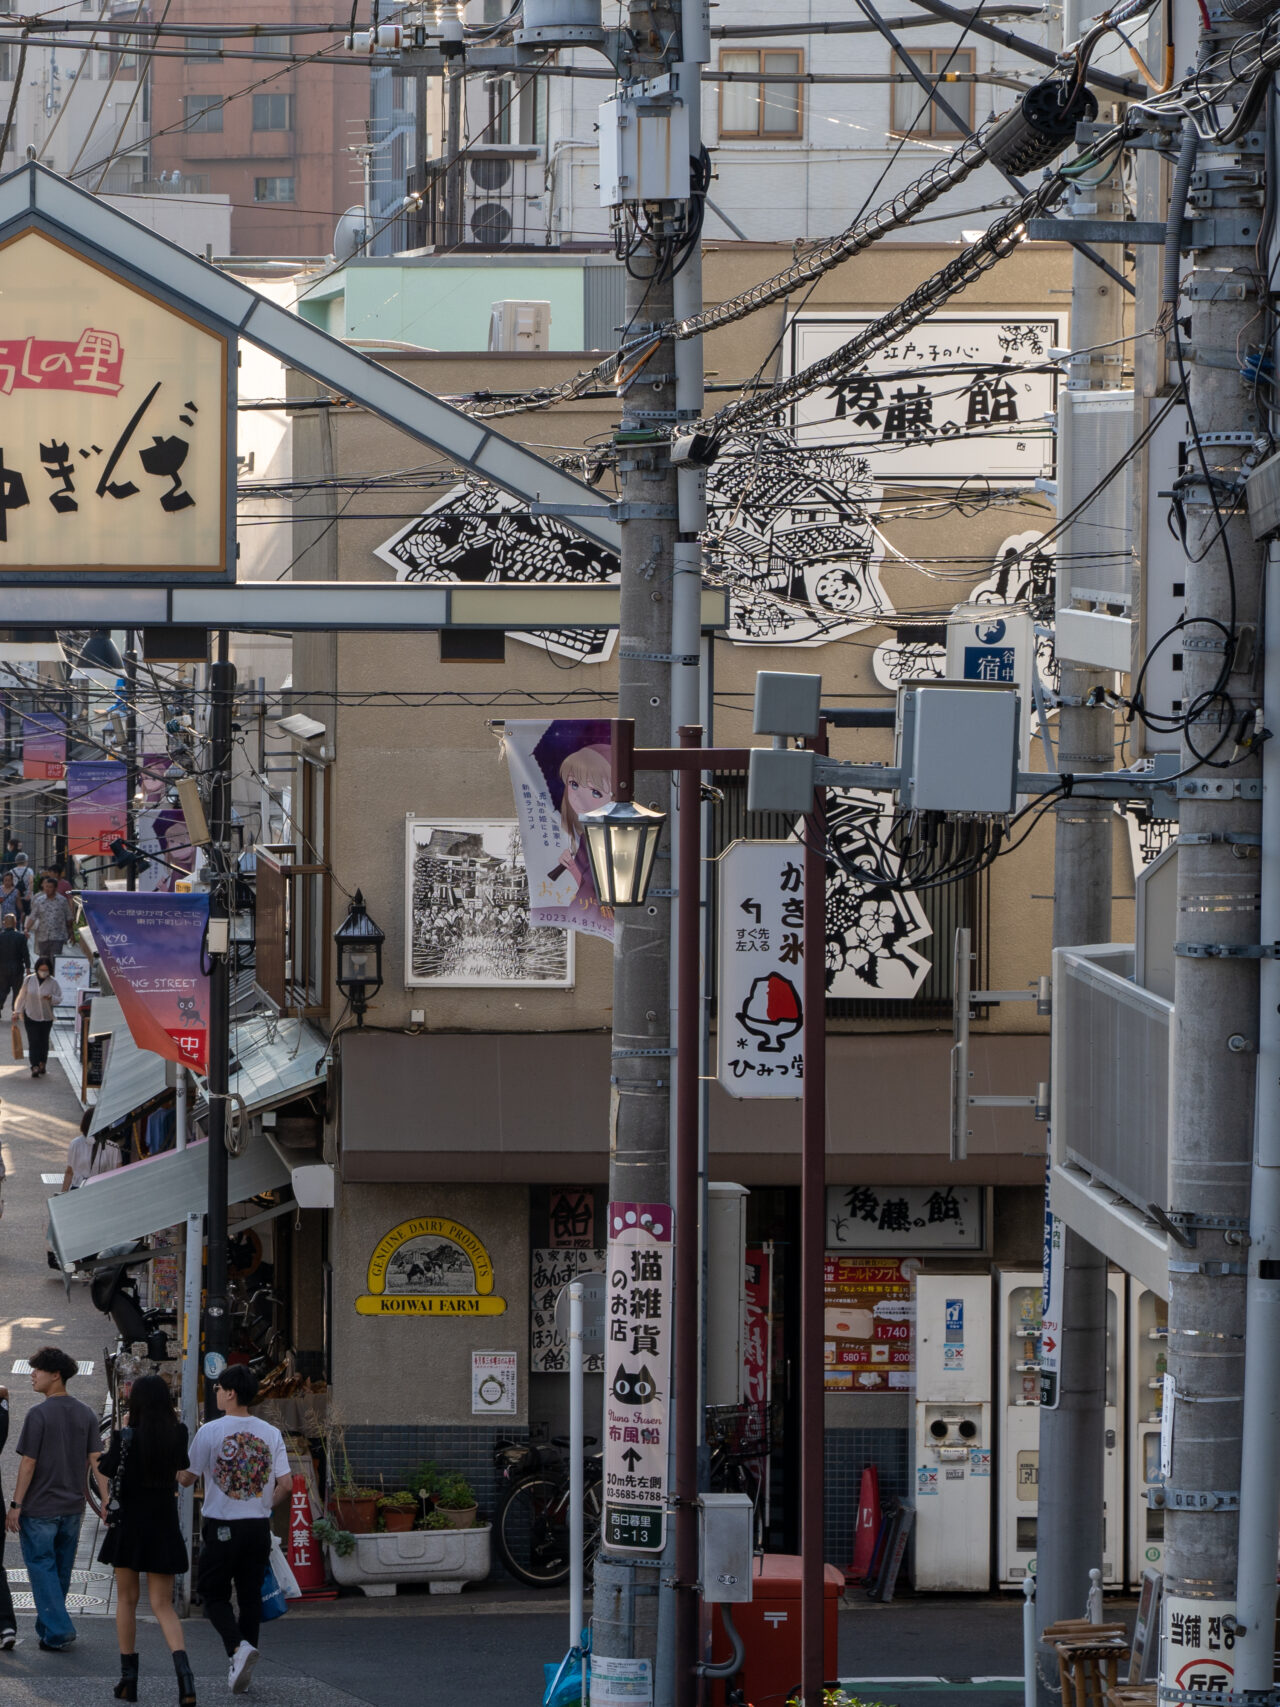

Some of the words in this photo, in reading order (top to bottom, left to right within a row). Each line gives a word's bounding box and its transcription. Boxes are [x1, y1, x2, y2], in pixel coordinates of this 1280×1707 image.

[883, 342, 980, 361] 江戸っ子の心
[825, 356, 1018, 447] 後藤の飴
[977, 655, 1000, 680] 宿
[1002, 650, 1015, 680] 谷中
[736, 928, 770, 940] すぐ先
[736, 940, 770, 952] 左入る
[155, 978, 197, 988] STREET
[727, 1054, 804, 1079] ひみつ堂
[550, 1194, 592, 1238] 飴
[843, 1186, 961, 1232] 後藤の飴
[372, 1229, 406, 1276] GENUINE
[409, 1221, 446, 1234] DAIRY
[449, 1226, 489, 1277] PRODUCTS
[839, 1269, 900, 1280] ゴールドソフト
[381, 1300, 432, 1311] KOIWAI
[440, 1300, 480, 1311] FARM
[610, 1269, 628, 1342] のお店
[630, 1250, 663, 1357] 猫雑貨
[877, 1326, 907, 1339] 1,740
[843, 1353, 859, 1361] 580
[894, 1353, 910, 1362] 200
[633, 1411, 662, 1425] Fusen
[609, 1425, 660, 1445] 布風船
[607, 1473, 662, 1489] 30m先左側
[607, 1487, 661, 1501] 03-5685-6788
[292, 1491, 311, 1566] 立入禁止
[611, 1512, 651, 1528] 西日暮里
[613, 1528, 649, 1542] 3-13
[1171, 1612, 1202, 1649] 当铺
